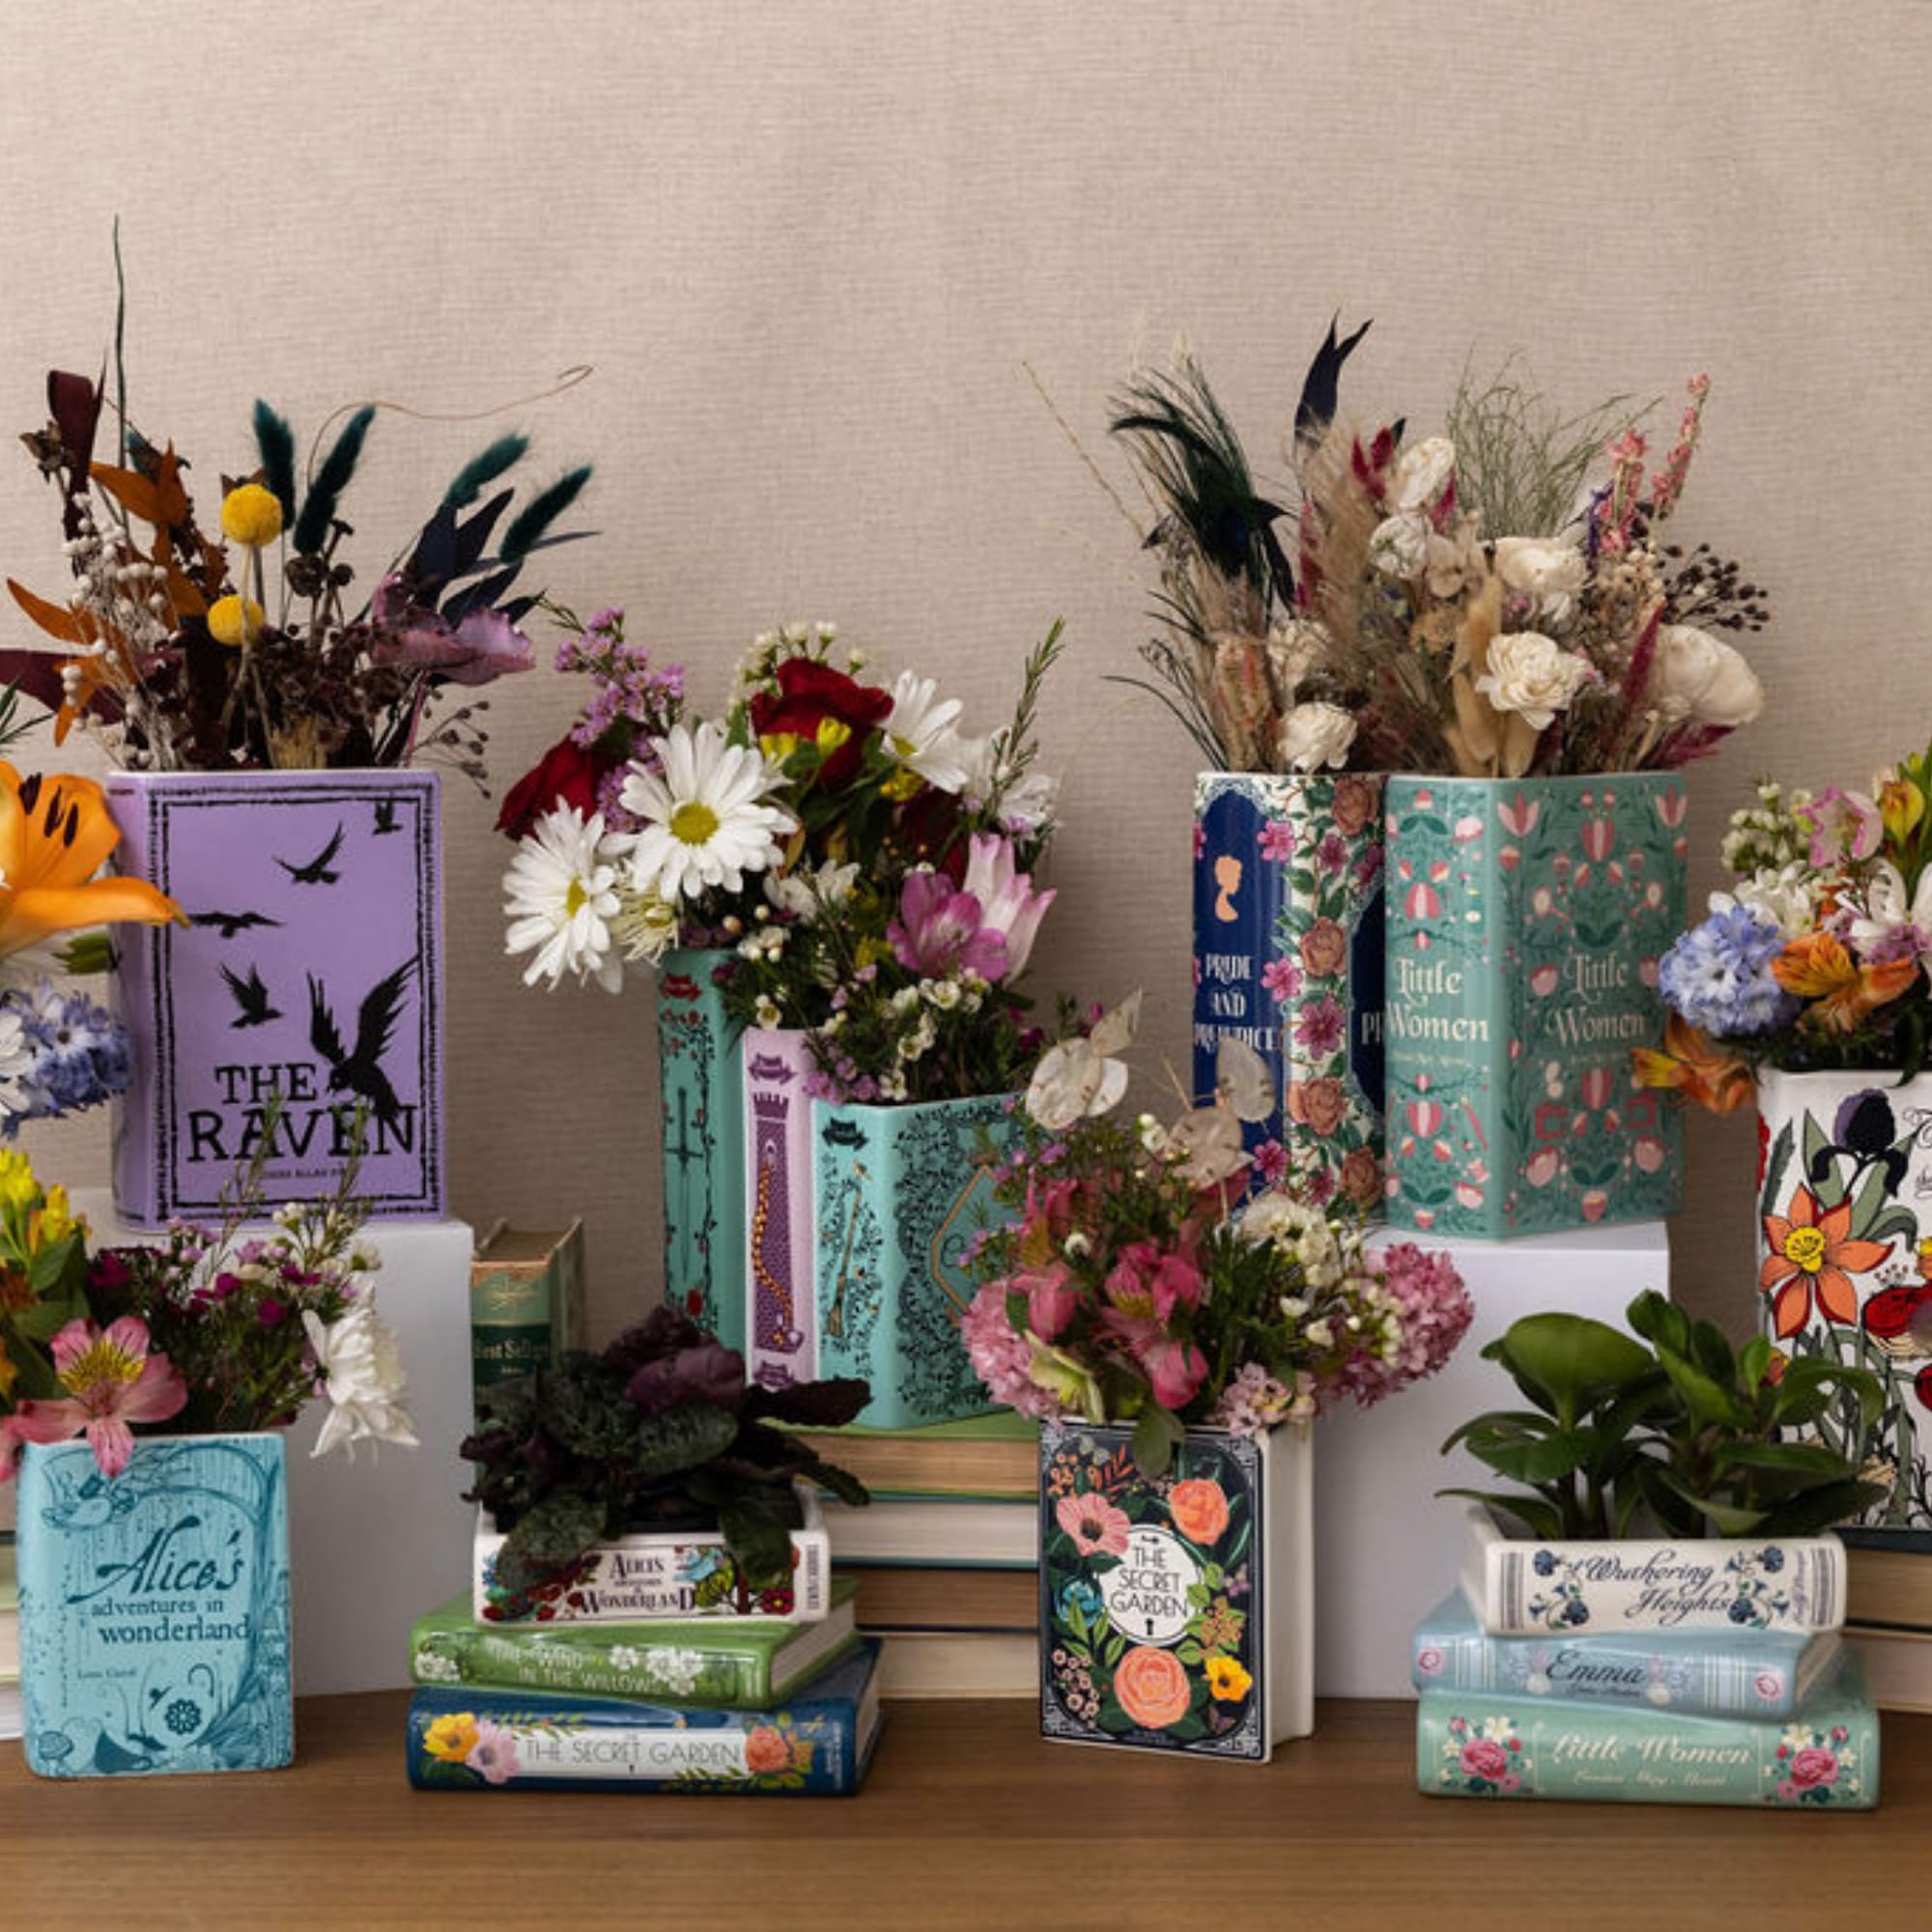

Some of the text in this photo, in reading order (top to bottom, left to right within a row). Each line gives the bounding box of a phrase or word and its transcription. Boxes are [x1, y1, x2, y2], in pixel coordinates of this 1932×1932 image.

[1205, 952, 1252, 984] PRIDE
[1394, 956, 1463, 1007] Little
[1212, 986, 1247, 1016] AND
[1385, 999, 1491, 1043] Women
[215, 1064, 317, 1104] THE
[186, 1105, 418, 1162] RAVEN
[67, 1516, 243, 1604] Alice's
[1133, 1547, 1167, 1569] THE
[1574, 1548, 1714, 1595] Wuthering
[1119, 1567, 1182, 1593] SECRET
[92, 1597, 224, 1617] adventures in
[1110, 1590, 1188, 1618] GARDEN
[1624, 1580, 1732, 1627] Heights
[99, 1614, 251, 1644] wonderland
[1546, 1648, 1646, 1684] Emma
[526, 1739, 740, 1767] THE SECRET GARDEN
[1552, 1734, 1753, 1765] Little Women
